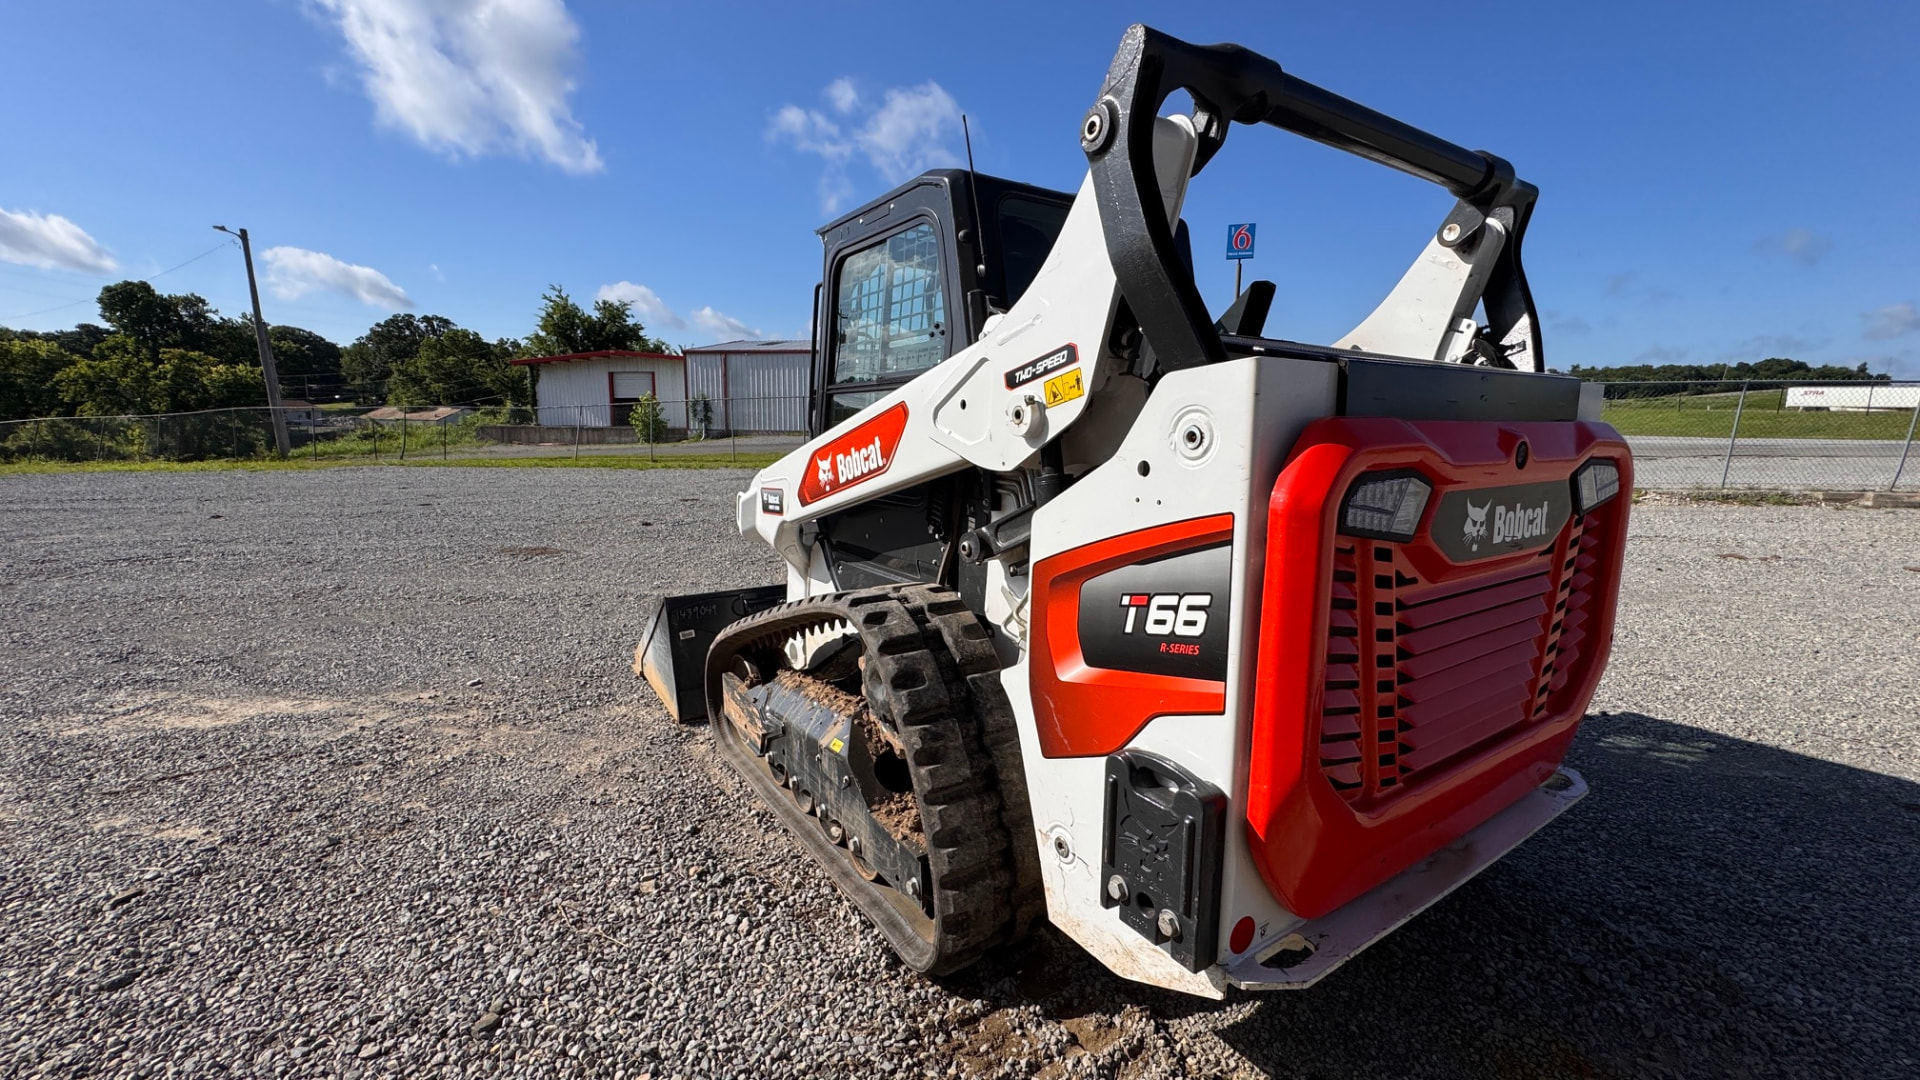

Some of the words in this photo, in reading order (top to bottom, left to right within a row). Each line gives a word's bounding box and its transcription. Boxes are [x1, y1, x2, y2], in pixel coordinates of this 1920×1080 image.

[1232, 224, 1252, 250] 6
[1015, 350, 1068, 383] TWO-SPEED
[836, 435, 884, 484] Bobcat
[1492, 500, 1549, 544] Bobcat
[1121, 593, 1212, 637] T66
[1160, 642, 1200, 656] R-SERIES
